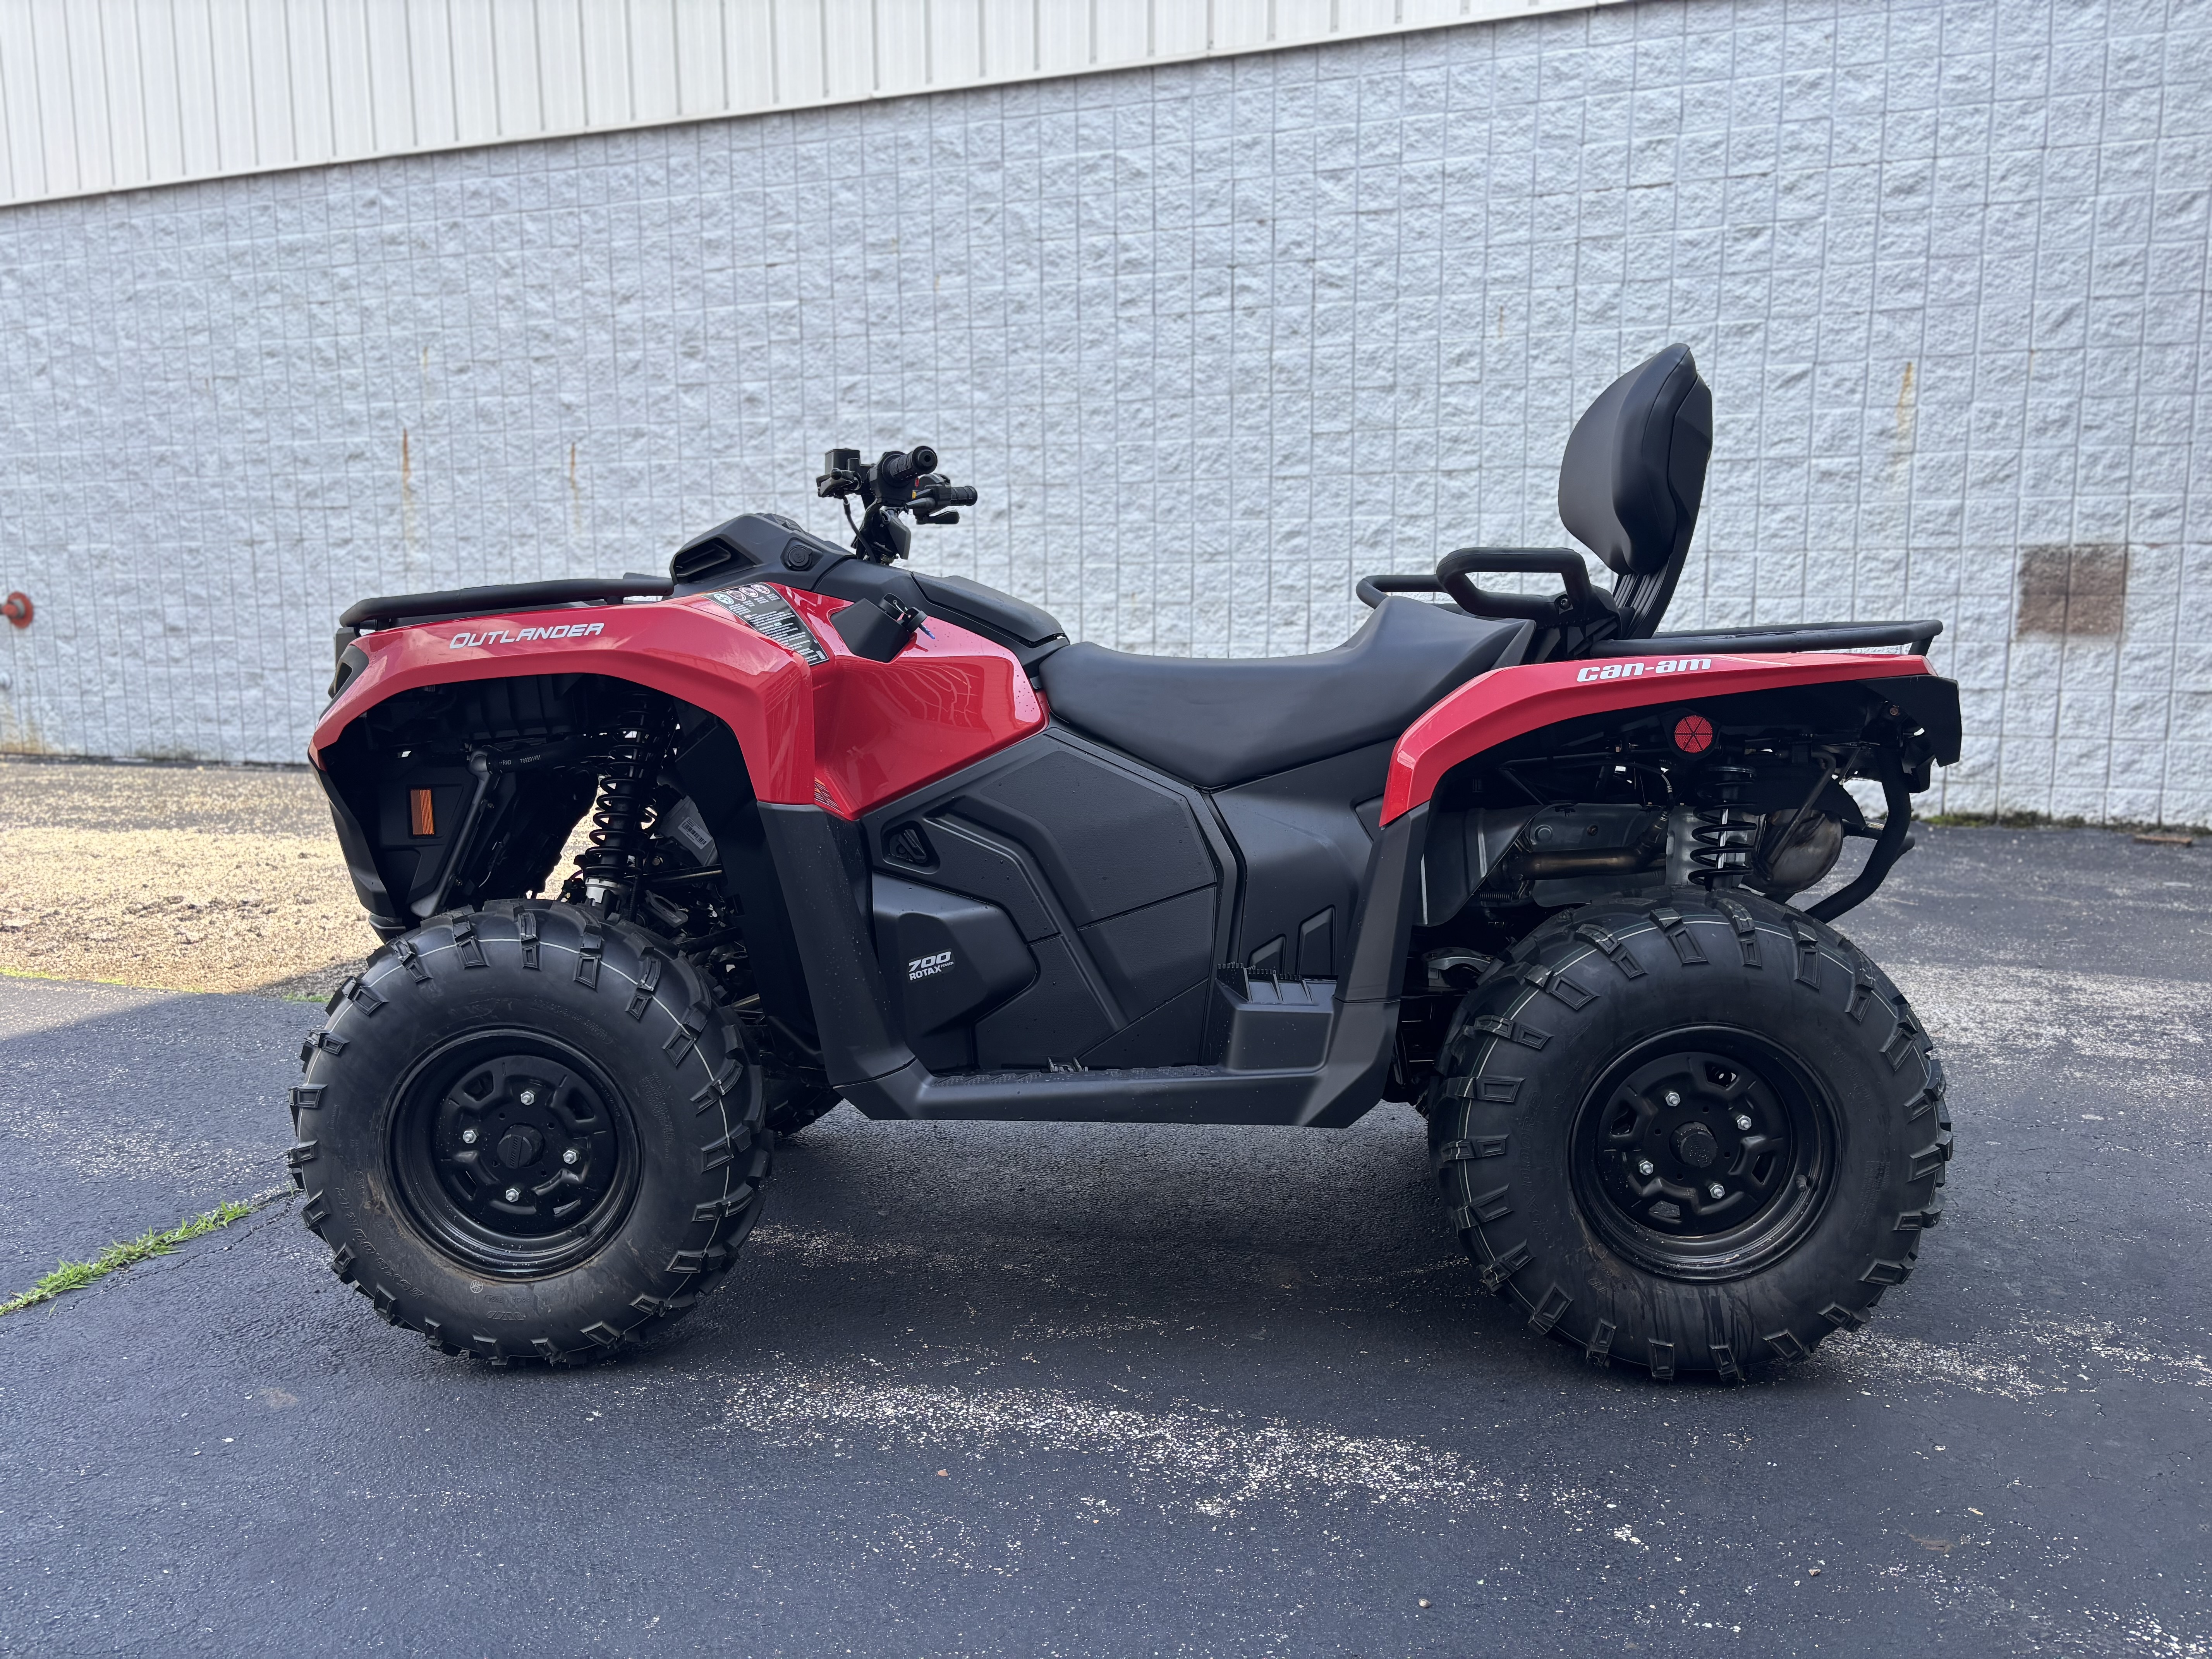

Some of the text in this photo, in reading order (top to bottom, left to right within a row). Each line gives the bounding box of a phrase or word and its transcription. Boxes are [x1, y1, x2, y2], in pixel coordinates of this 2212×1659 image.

[449, 622, 605, 649] OUTLANDER
[1577, 658, 1712, 682] can-am
[908, 951, 951, 973] 700
[909, 965, 942, 981] ROTAX
